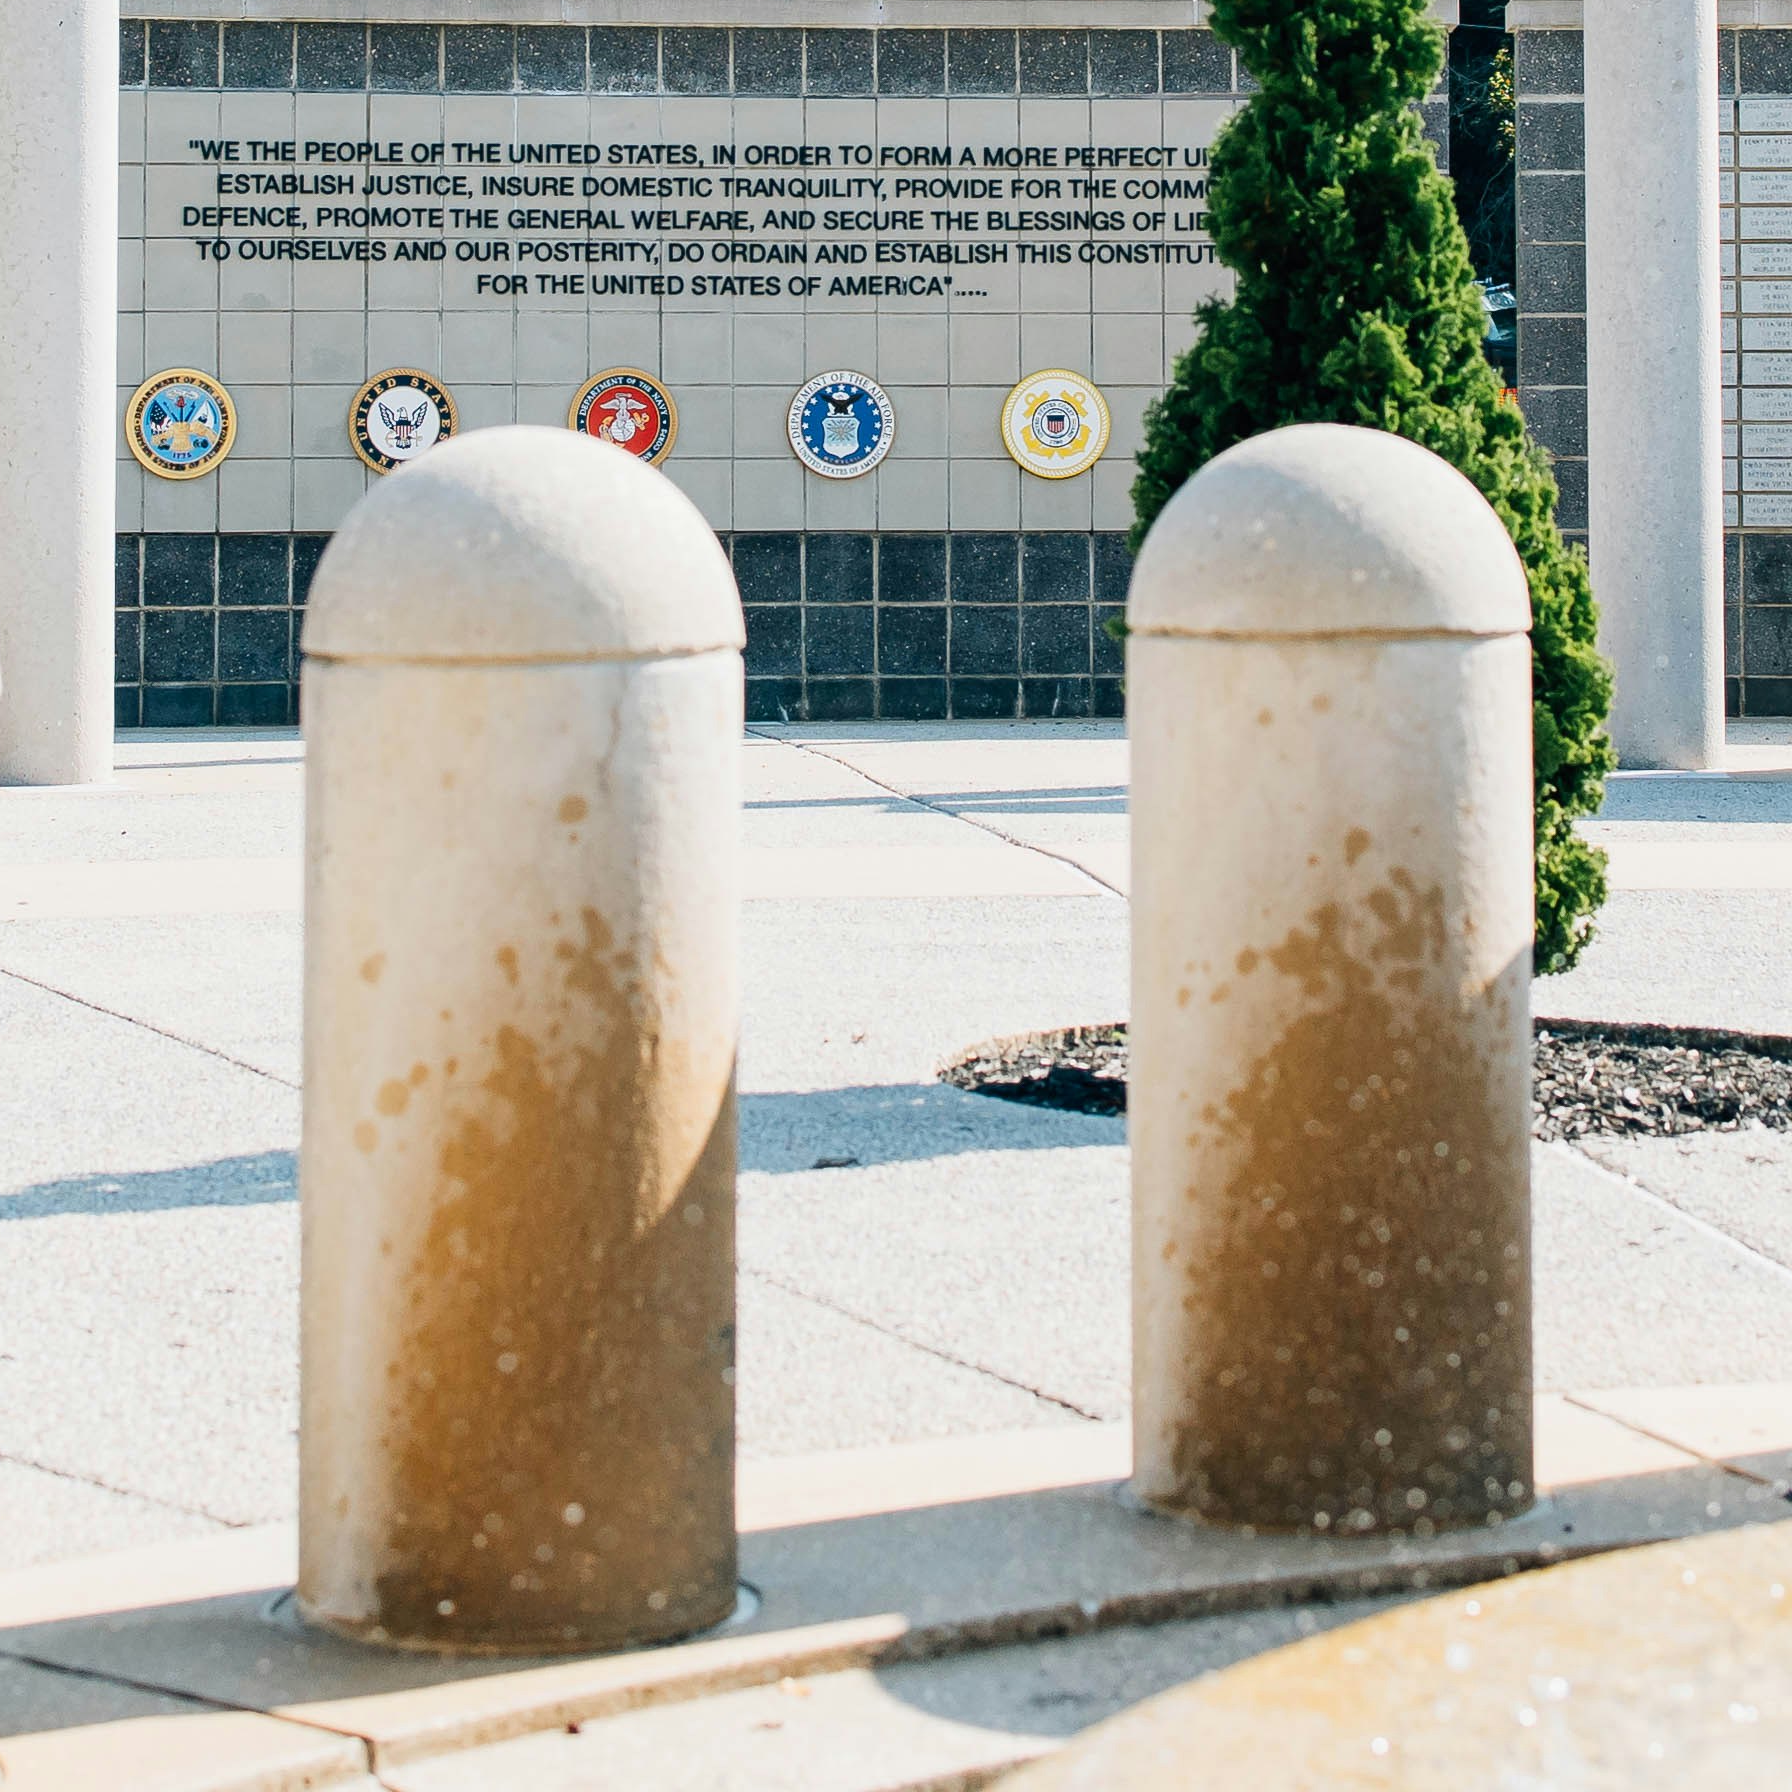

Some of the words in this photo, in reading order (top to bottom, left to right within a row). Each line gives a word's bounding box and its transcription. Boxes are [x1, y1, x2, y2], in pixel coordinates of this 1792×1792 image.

[189, 140, 239, 161] "WE
[246, 141, 296, 161] THE
[304, 141, 403, 162] PEOPLE
[410, 143, 444, 163] OF
[451, 143, 501, 163] THE
[508, 143, 601, 164] UNITED
[607, 144, 705, 168] STATES,
[712, 145, 736, 165] IN
[744, 145, 832, 166] ORDER
[838, 146, 872, 166] TO
[880, 146, 952, 166] FORM
[958, 147, 977, 166] A
[983, 146, 1058, 167] MORE
[1064, 147, 1178, 167] PERFECT
[217, 173, 355, 194] ESTABLISH
[361, 174, 474, 198] JUSTICE,
[481, 176, 575, 196] INSURE
[582, 177, 713, 197] DOMESTIC
[719, 178, 888, 202] TRANQUILITY,
[895, 178, 1004, 198] PROVIDE
[1010, 179, 1062, 198] FOR
[1067, 179, 1117, 199] THE
[182, 206, 308, 230] DEFENCE,
[316, 207, 444, 227] PROMOTE
[449, 209, 499, 229] THE
[508, 209, 625, 230] GENERAL
[631, 210, 756, 233] WELFARE,
[762, 210, 816, 231] AND
[822, 210, 924, 231] SECURE
[930, 211, 979, 231] THE
[986, 211, 1126, 231] BLESSINGS
[1132, 211, 1166, 231] OF
[196, 240, 231, 261] TO
[237, 240, 387, 261] OURSELVES
[393, 242, 448, 262] AND
[455, 241, 511, 262] OUR
[518, 242, 660, 266] POSTERITY,
[668, 243, 705, 263] DO
[711, 243, 808, 264] ORDAIN
[814, 244, 868, 264] AND
[875, 243, 1009, 264] ESTABLISH
[1015, 244, 1072, 264] THIS
[1077, 244, 1223, 265] CONSTITUT
[476, 274, 528, 295] FOR
[535, 274, 585, 295] THE
[591, 275, 685, 296] UNITED
[691, 275, 782, 296] STATES
[787, 276, 822, 296] OF
[134, 376, 181, 419] DEPARTMENT
[183, 376, 196, 384] OF
[357, 377, 397, 441] UNITED
[410, 377, 451, 441] STATES
[578, 376, 625, 416] DEPARTMENT
[638, 380, 652, 393] THE
[651, 391, 668, 416] NAVY
[791, 375, 829, 439] DEPARTMENT
[830, 373, 847, 383] OF
[848, 373, 870, 387] THE
[868, 385, 887, 404] AIR
[882, 403, 894, 440] FORCE
[798, 447, 823, 470] UNITED
[821, 464, 849, 476] STATES
[849, 466, 860, 475] OF
[860, 446, 886, 470] AMERICA
